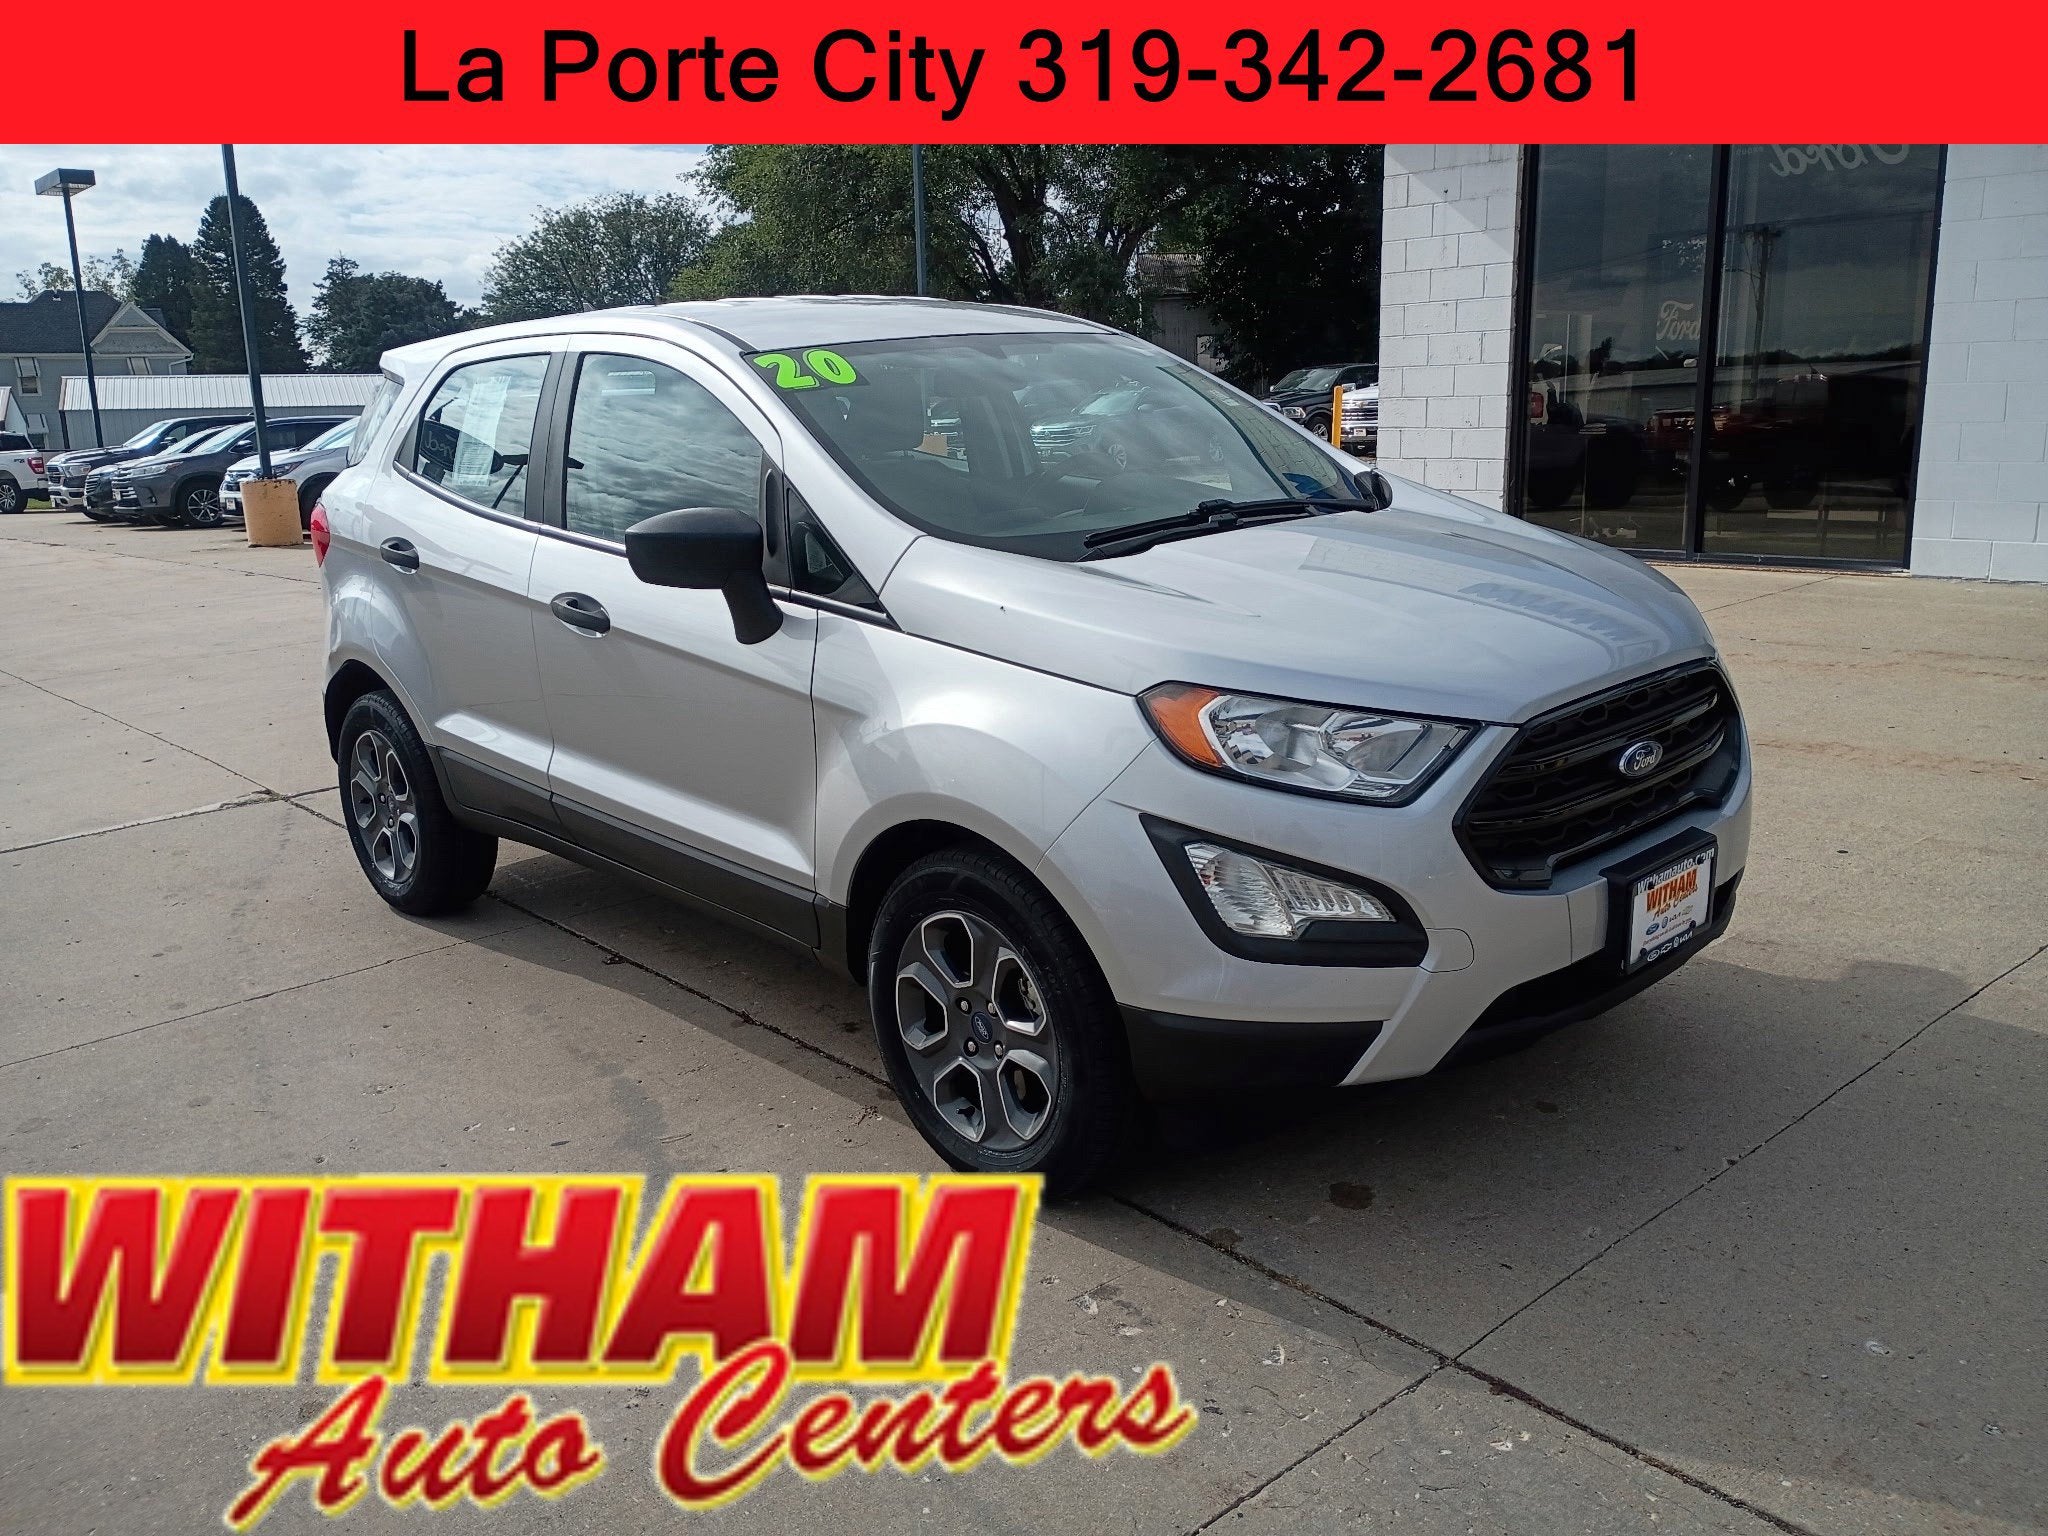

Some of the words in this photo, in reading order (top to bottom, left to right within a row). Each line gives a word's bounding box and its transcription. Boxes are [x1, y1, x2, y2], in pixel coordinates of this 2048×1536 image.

[1656, 300, 1701, 340] Ford
[753, 347, 857, 389] 20
[1633, 747, 1657, 771] Ford
[1646, 868, 1698, 912] WITHAM
